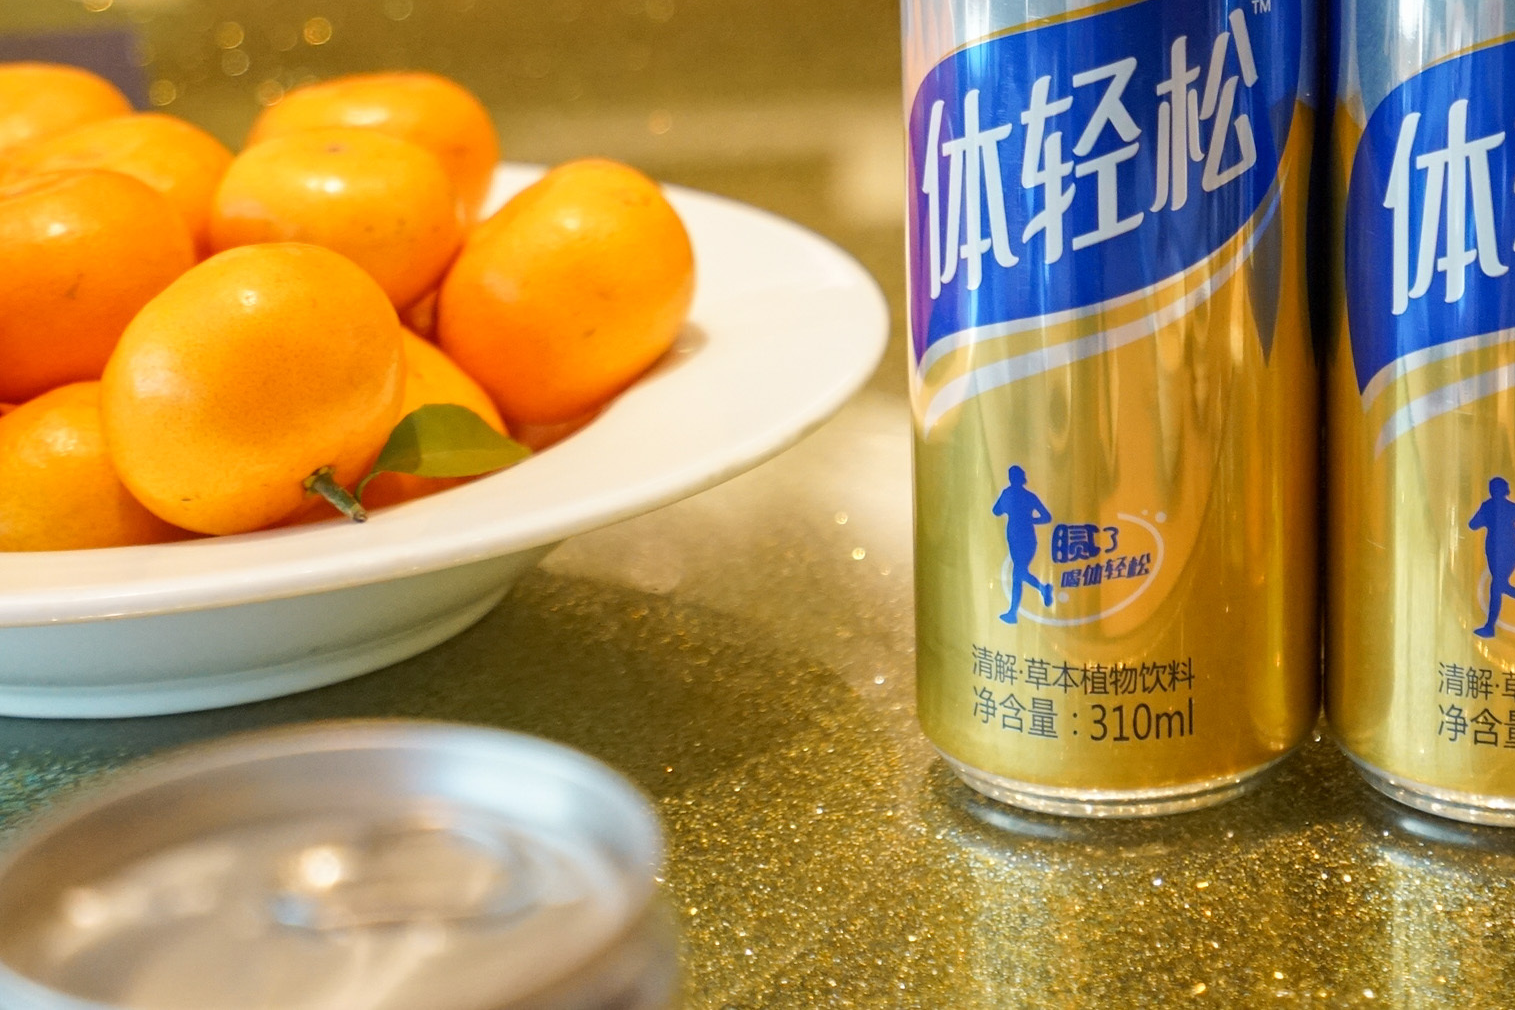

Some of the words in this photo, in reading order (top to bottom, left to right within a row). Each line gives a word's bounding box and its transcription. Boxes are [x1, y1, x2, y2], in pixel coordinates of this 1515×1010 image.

[922, 7, 1258, 300] 体轻松
[1061, 553, 1151, 588] 喝体轻松
